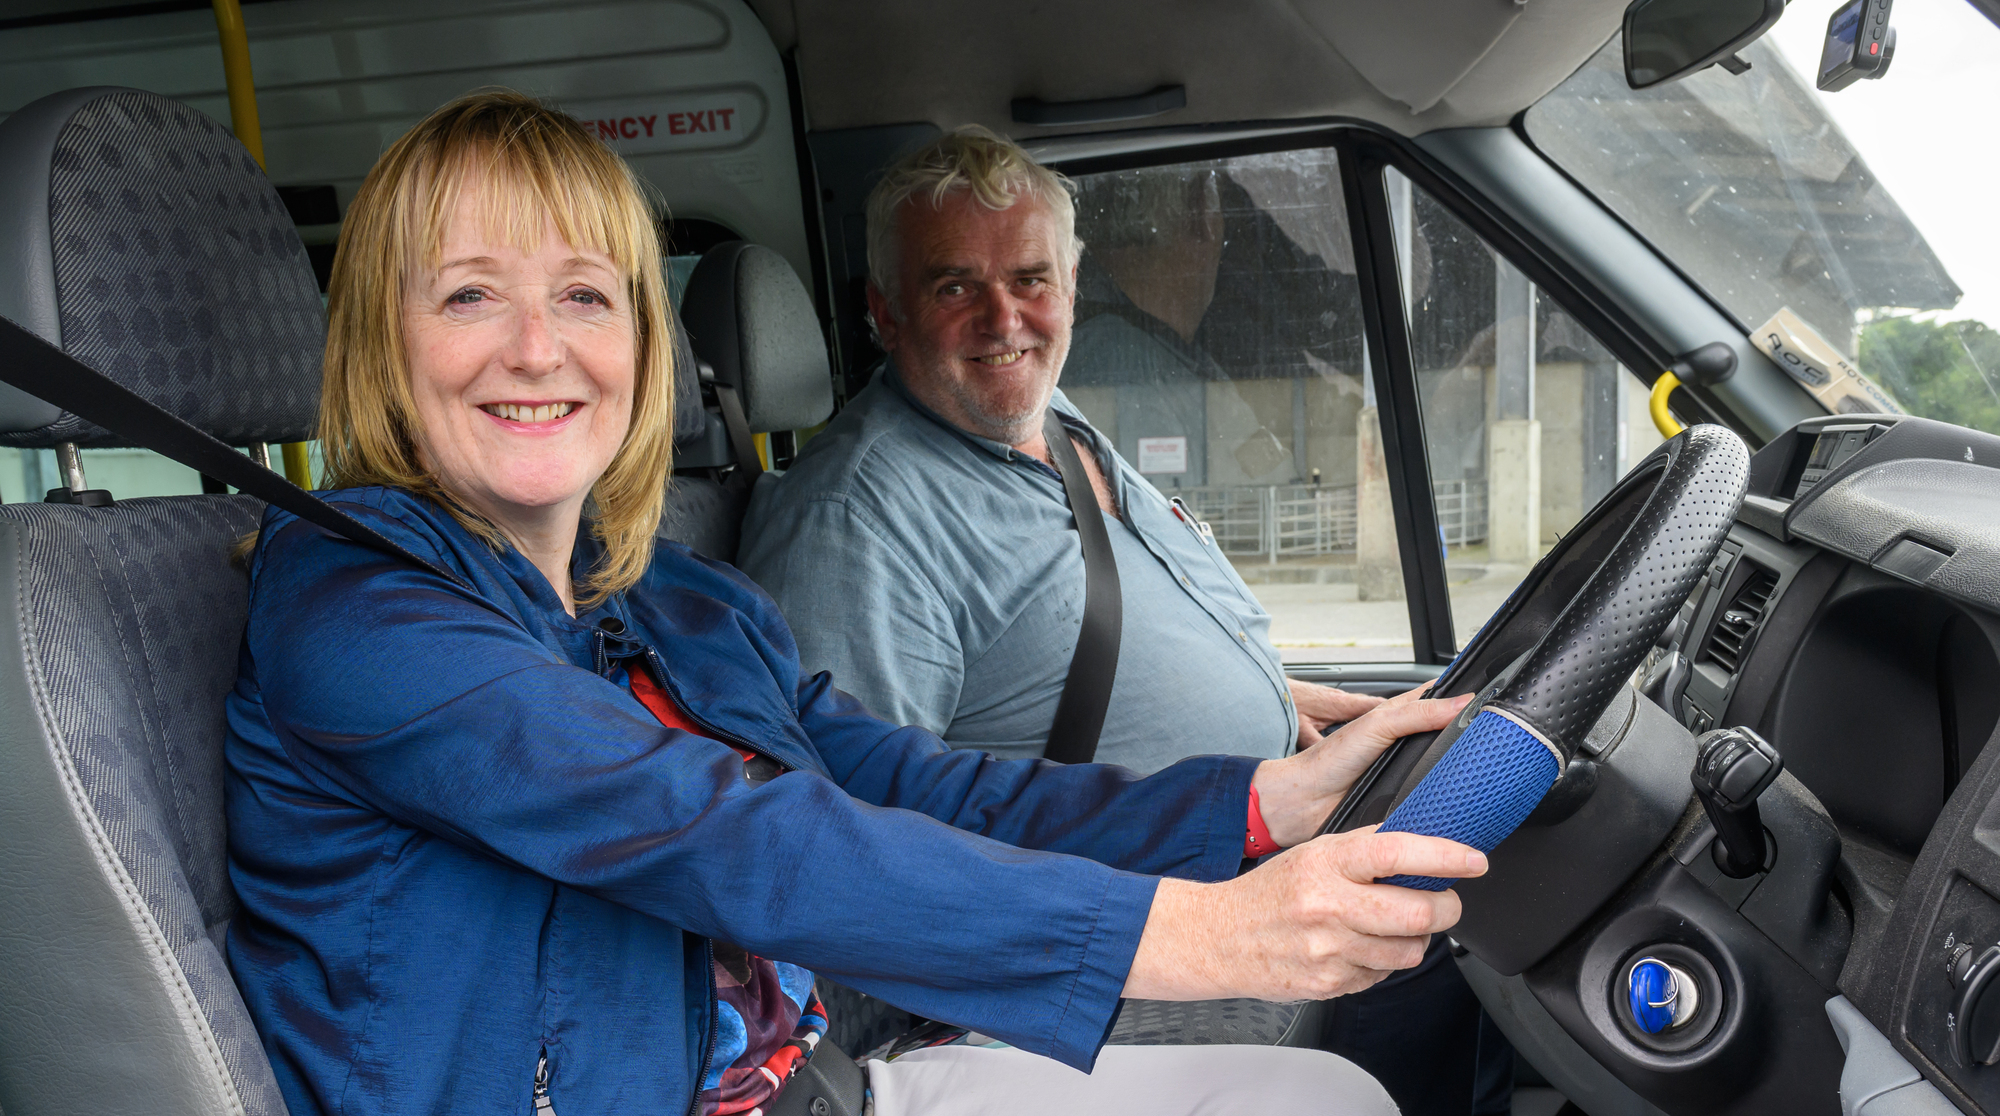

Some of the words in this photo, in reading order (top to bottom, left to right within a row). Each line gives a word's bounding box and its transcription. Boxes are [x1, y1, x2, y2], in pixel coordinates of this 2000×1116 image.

[582, 115, 657, 141] ENCY
[667, 108, 735, 135] EXIT
[1866, 386, 1900, 414] COMM
